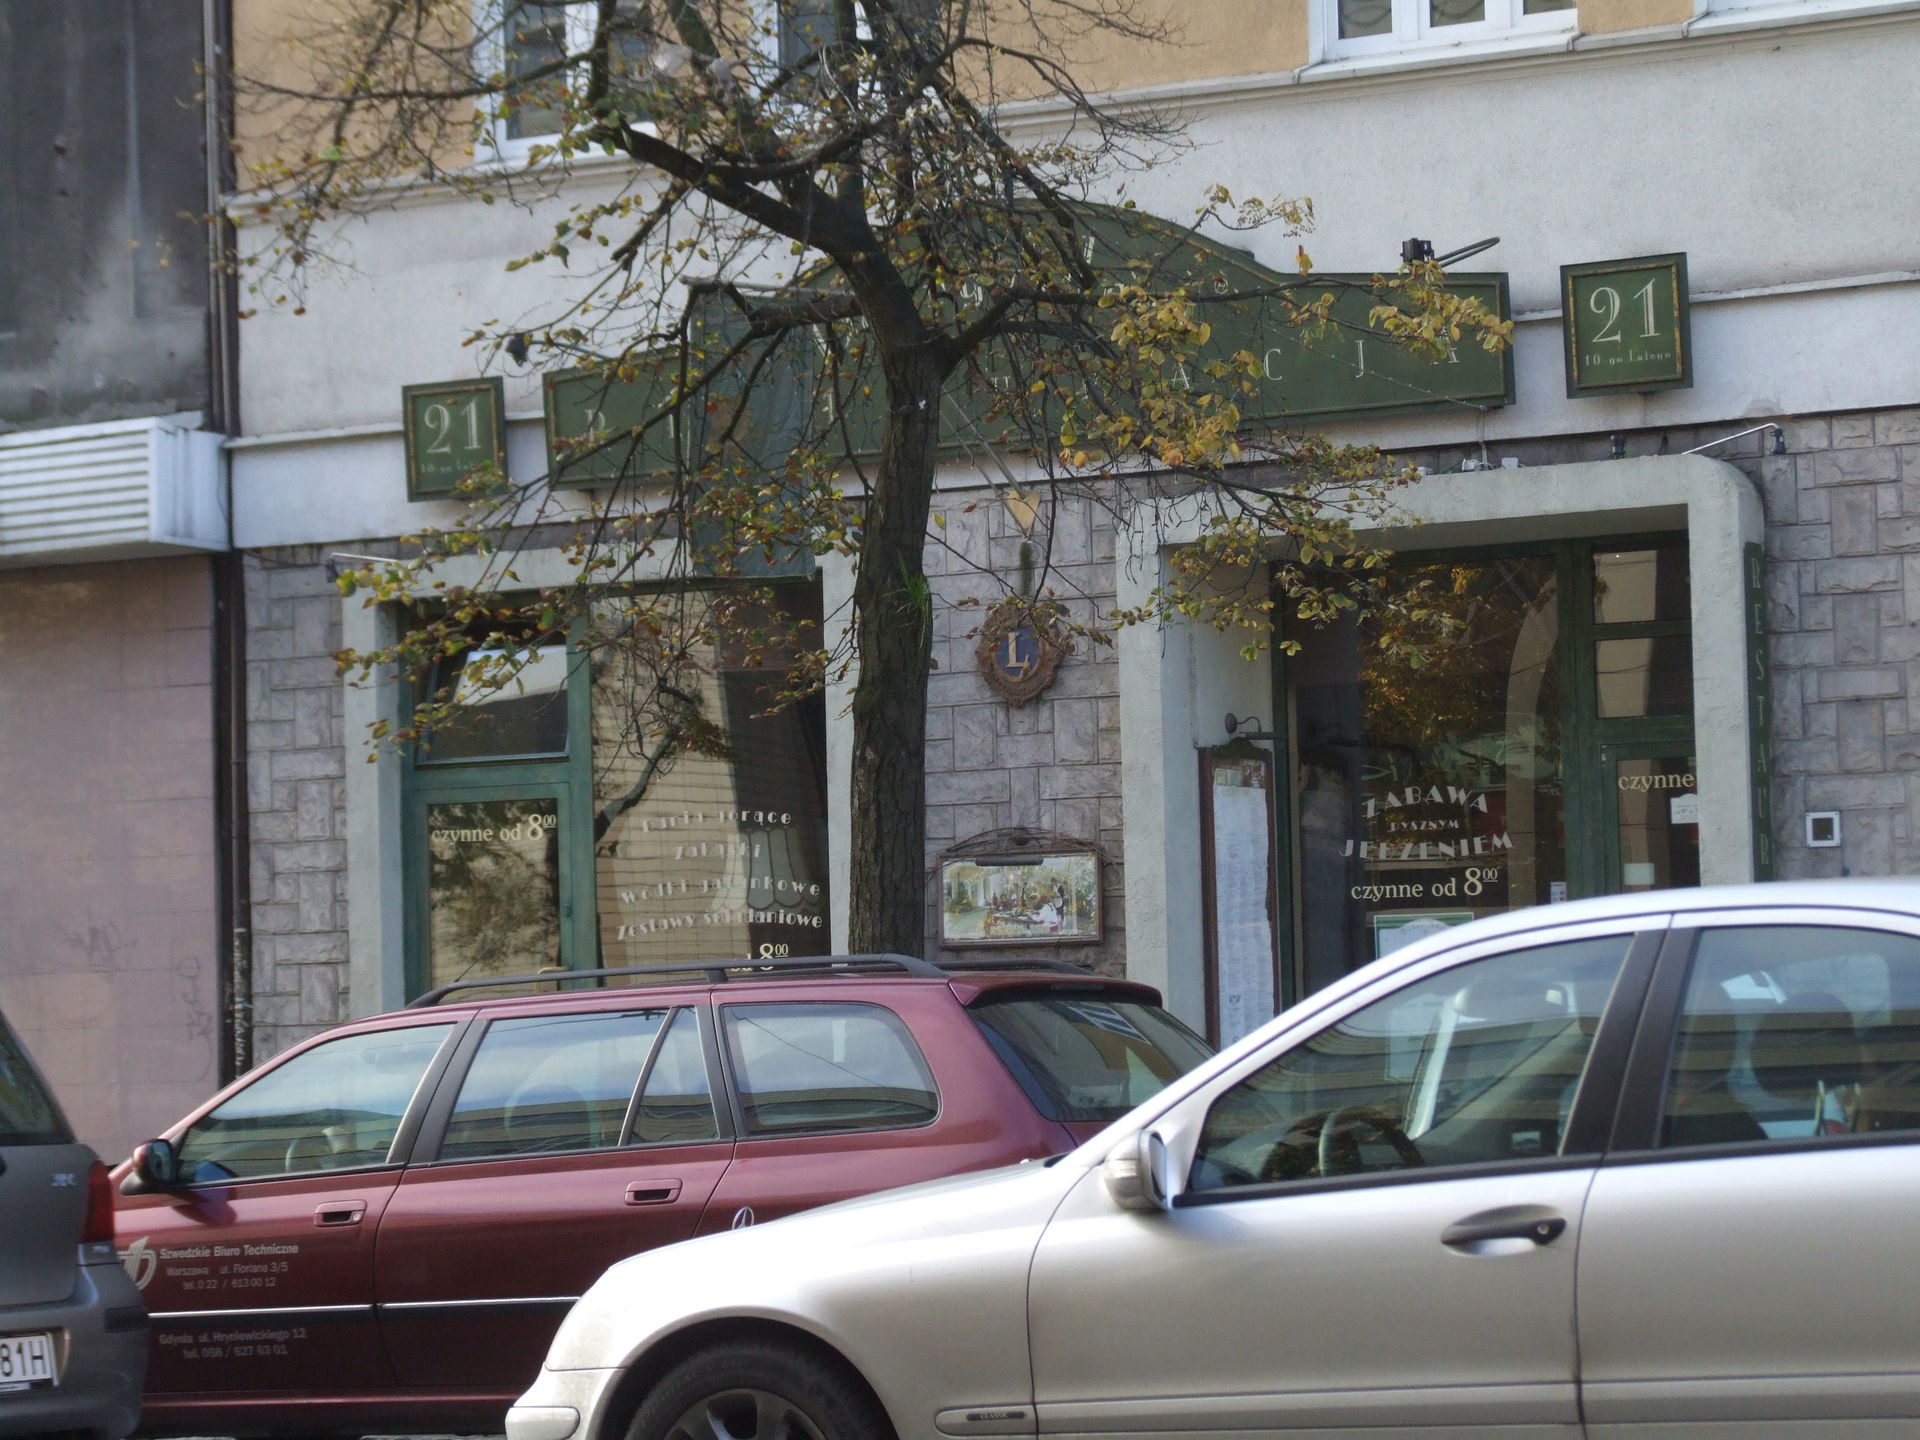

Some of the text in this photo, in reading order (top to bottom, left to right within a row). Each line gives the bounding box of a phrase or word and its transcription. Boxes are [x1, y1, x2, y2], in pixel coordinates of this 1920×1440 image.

[1590, 278, 1661, 343] 21
[424, 397, 482, 453] 21
[1617, 773, 1695, 792] czynne
[1361, 784, 1488, 819] ZABAWA
[431, 827, 493, 845] czynne
[499, 823, 521, 841] od
[1338, 831, 1514, 861] JEDZENIEM
[1351, 883, 1424, 902] czynne
[1431, 878, 1457, 896] od
[160, 1243, 300, 1259] Szwedzkie Biuro Techniczne
[291, 1327, 307, 1339] 12
